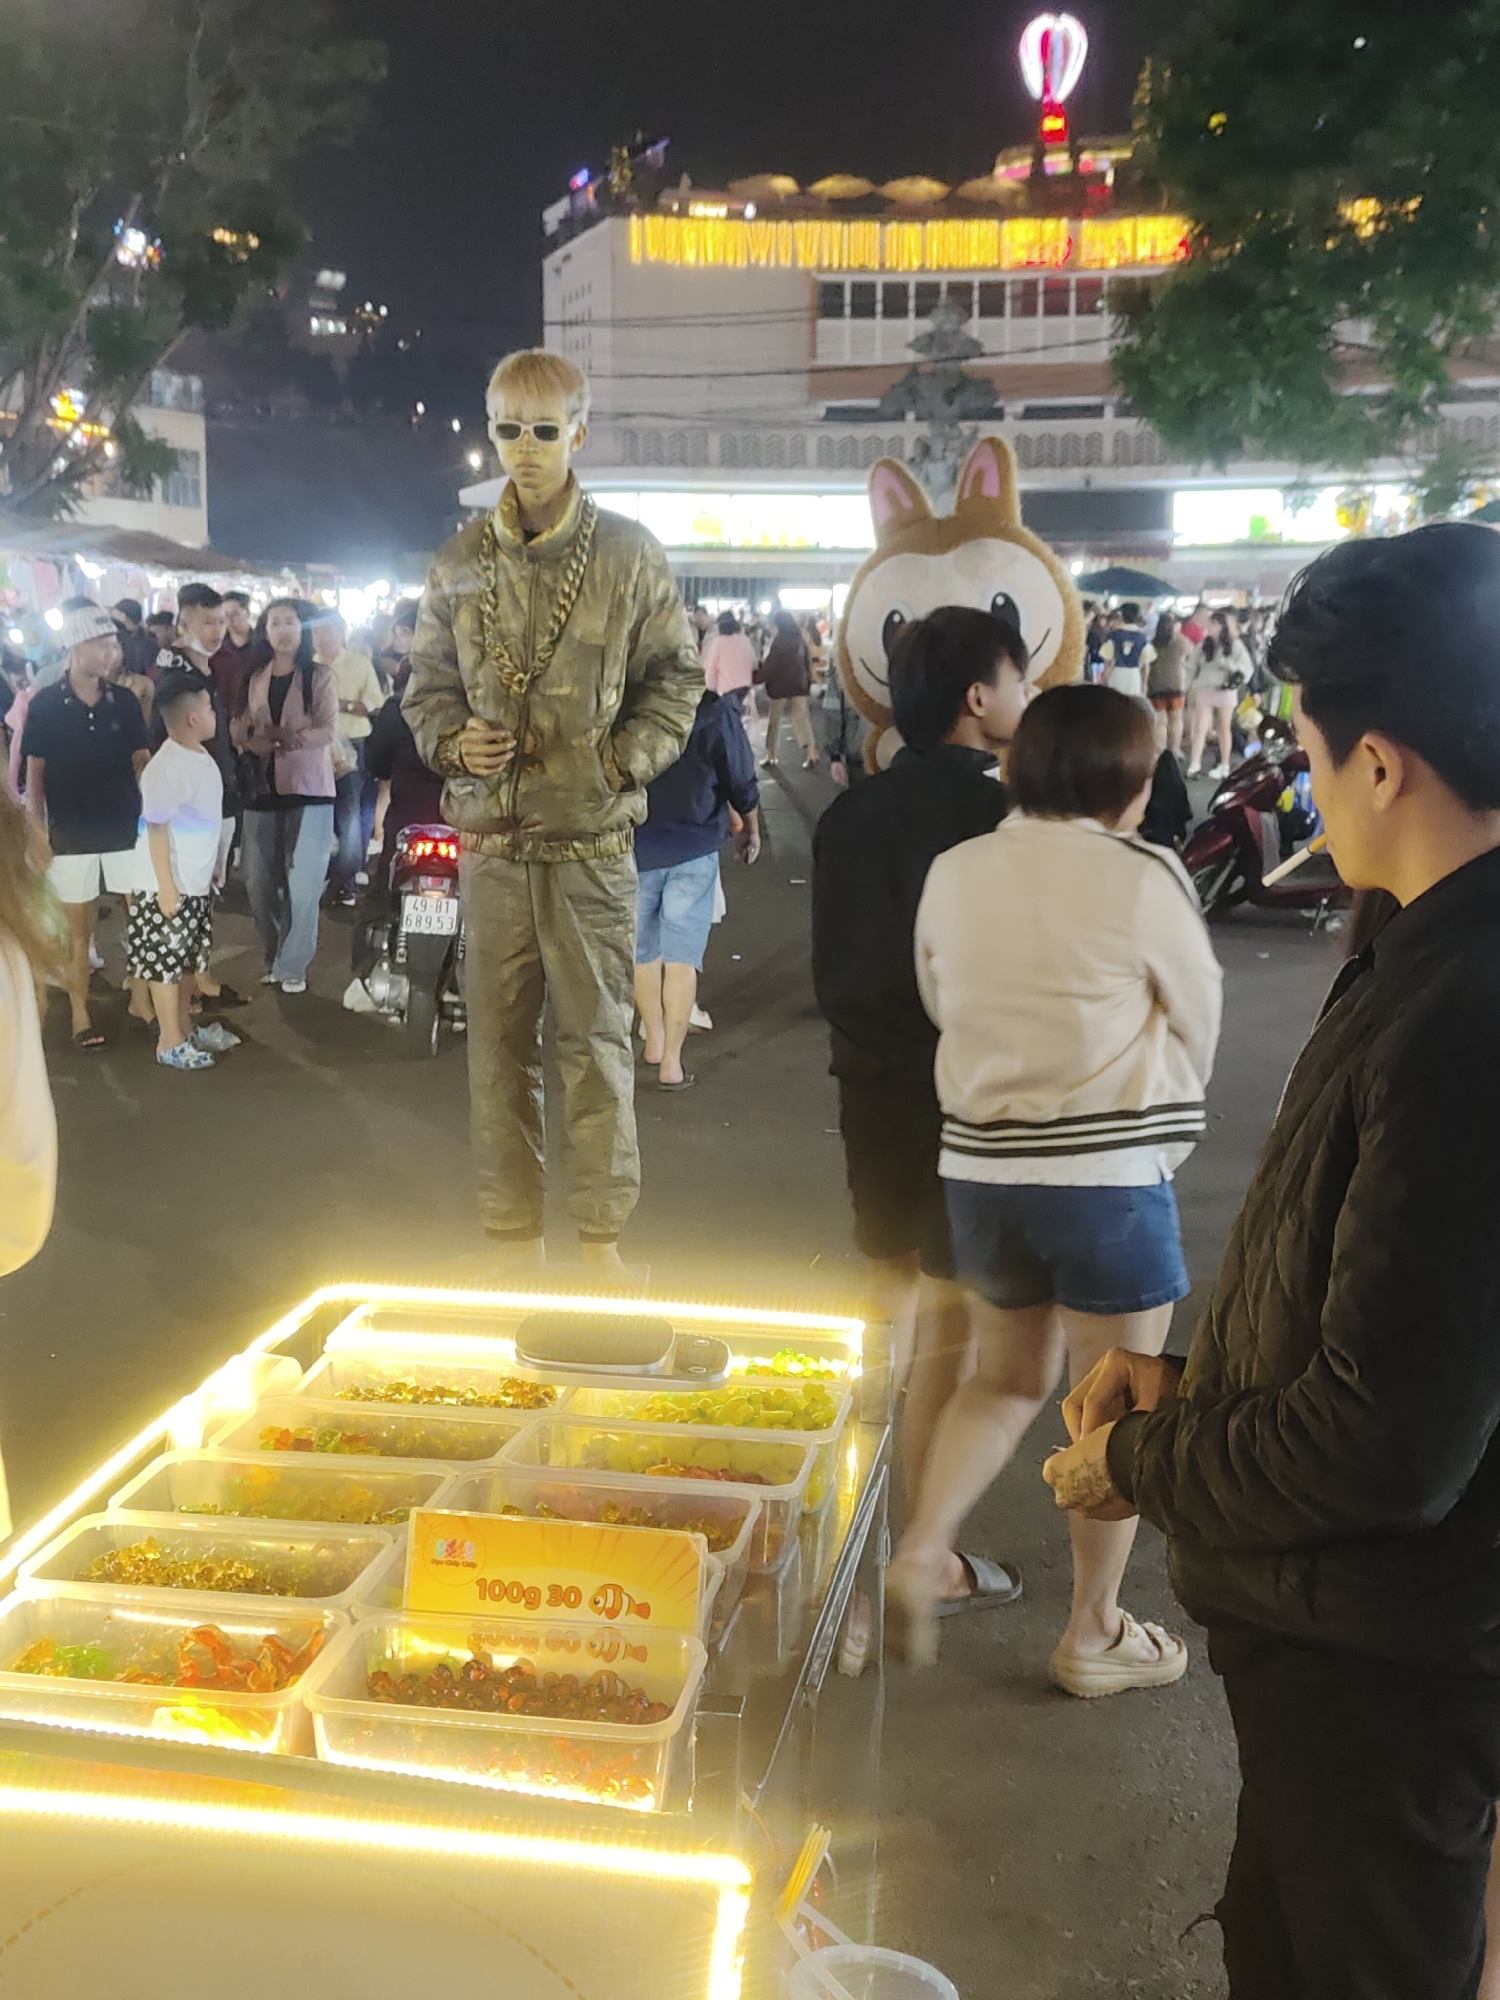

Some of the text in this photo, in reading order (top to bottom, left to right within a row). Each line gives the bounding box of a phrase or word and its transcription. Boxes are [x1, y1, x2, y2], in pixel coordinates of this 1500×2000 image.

[412, 897, 450, 914] 49-B1
[405, 914, 454, 931] 689.53
[476, 1578, 582, 1610] 100g 30
[545, 1628, 581, 1654] 60
